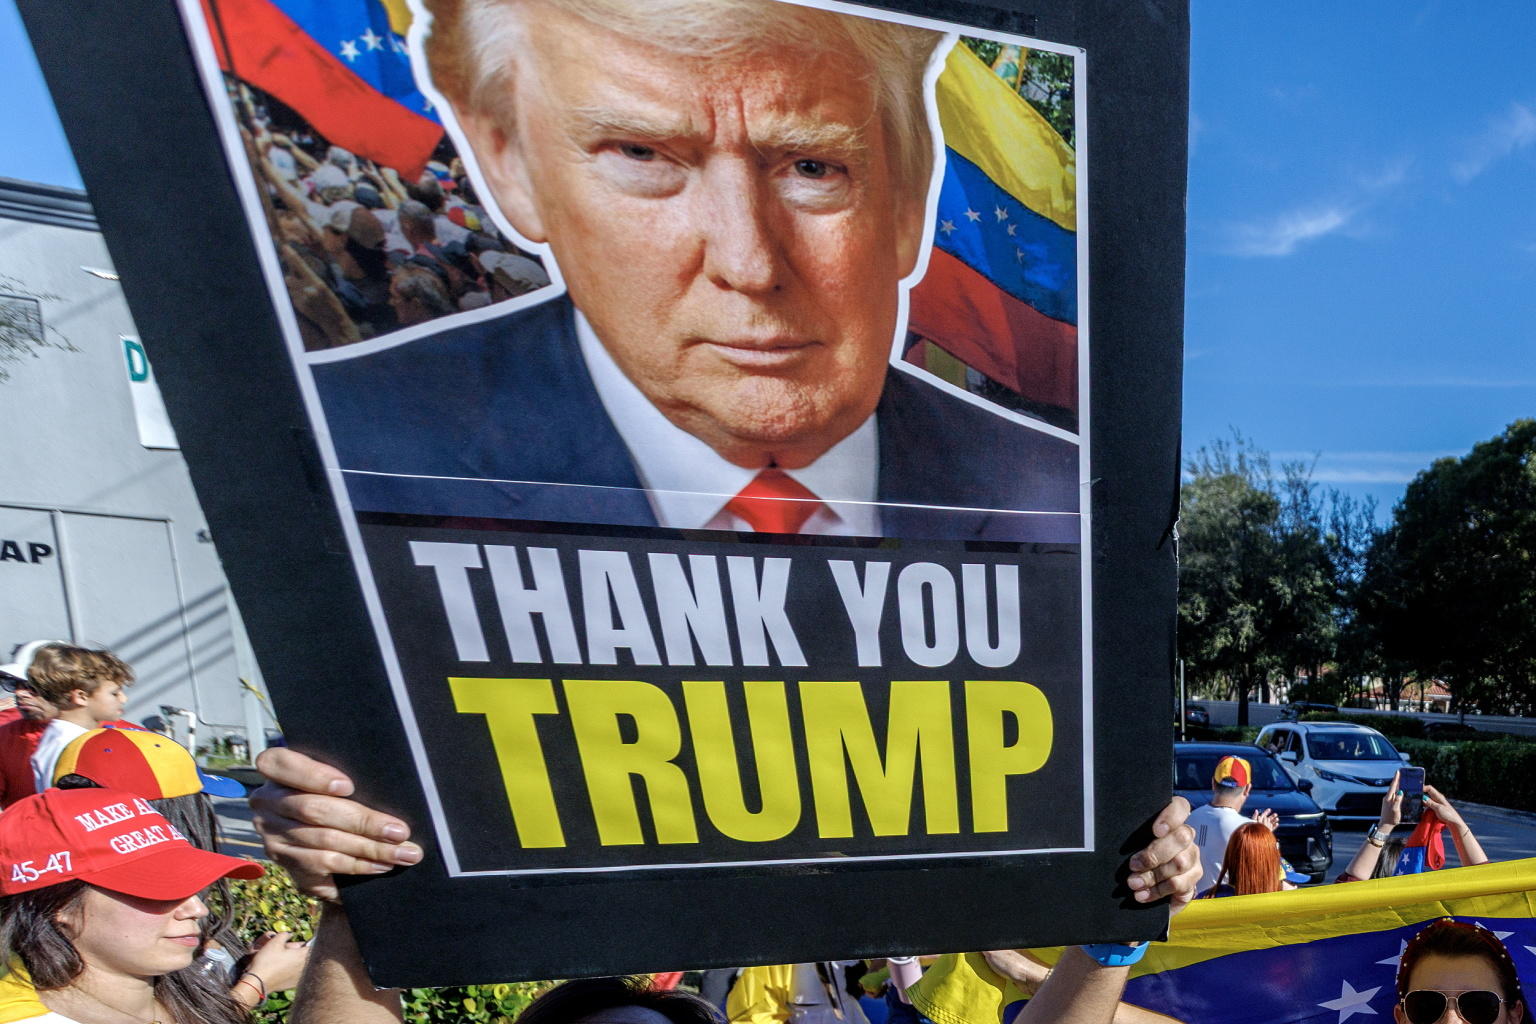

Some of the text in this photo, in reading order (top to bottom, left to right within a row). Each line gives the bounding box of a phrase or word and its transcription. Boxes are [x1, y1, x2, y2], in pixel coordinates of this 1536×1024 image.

[409, 540, 1021, 668] THANK YOU
[447, 676, 1054, 849] TRUMP
[75, 802, 135, 832] MAKE
[109, 825, 170, 854] GREAT
[11, 850, 73, 883] 45-47
